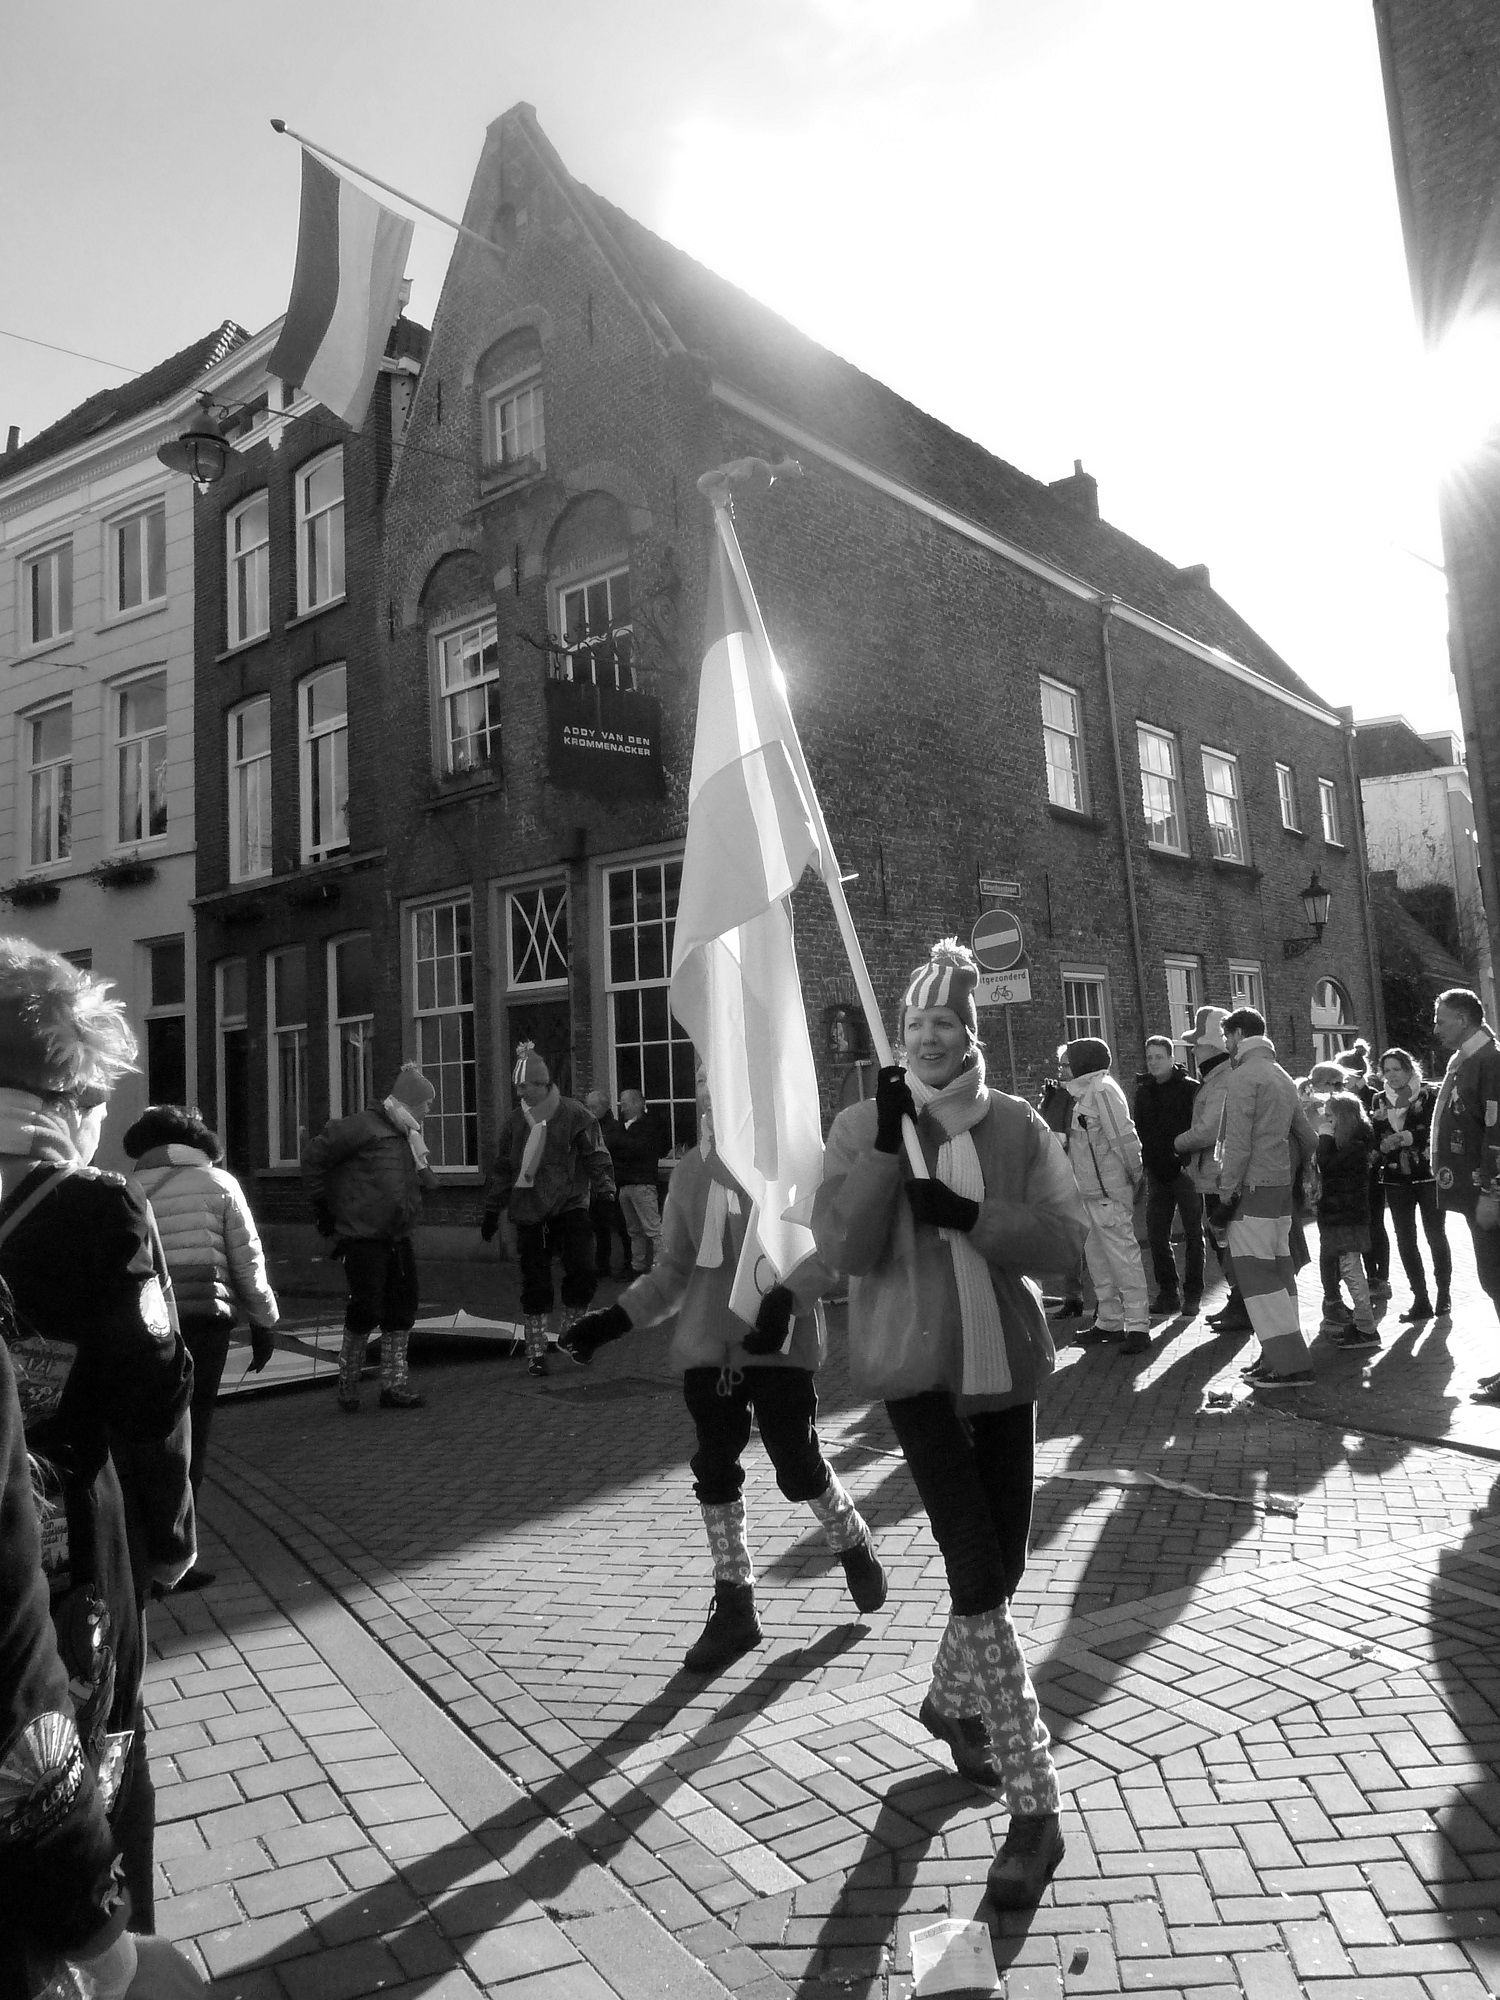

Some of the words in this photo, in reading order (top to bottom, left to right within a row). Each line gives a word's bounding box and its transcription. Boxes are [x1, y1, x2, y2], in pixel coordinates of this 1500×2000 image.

[563, 726, 595, 737] ADDY
[601, 731, 624, 742] VAN
[628, 735, 650, 746] DEN
[563, 736, 651, 756] KROMMENACKER
[979, 972, 1026, 985] itgezonderd
